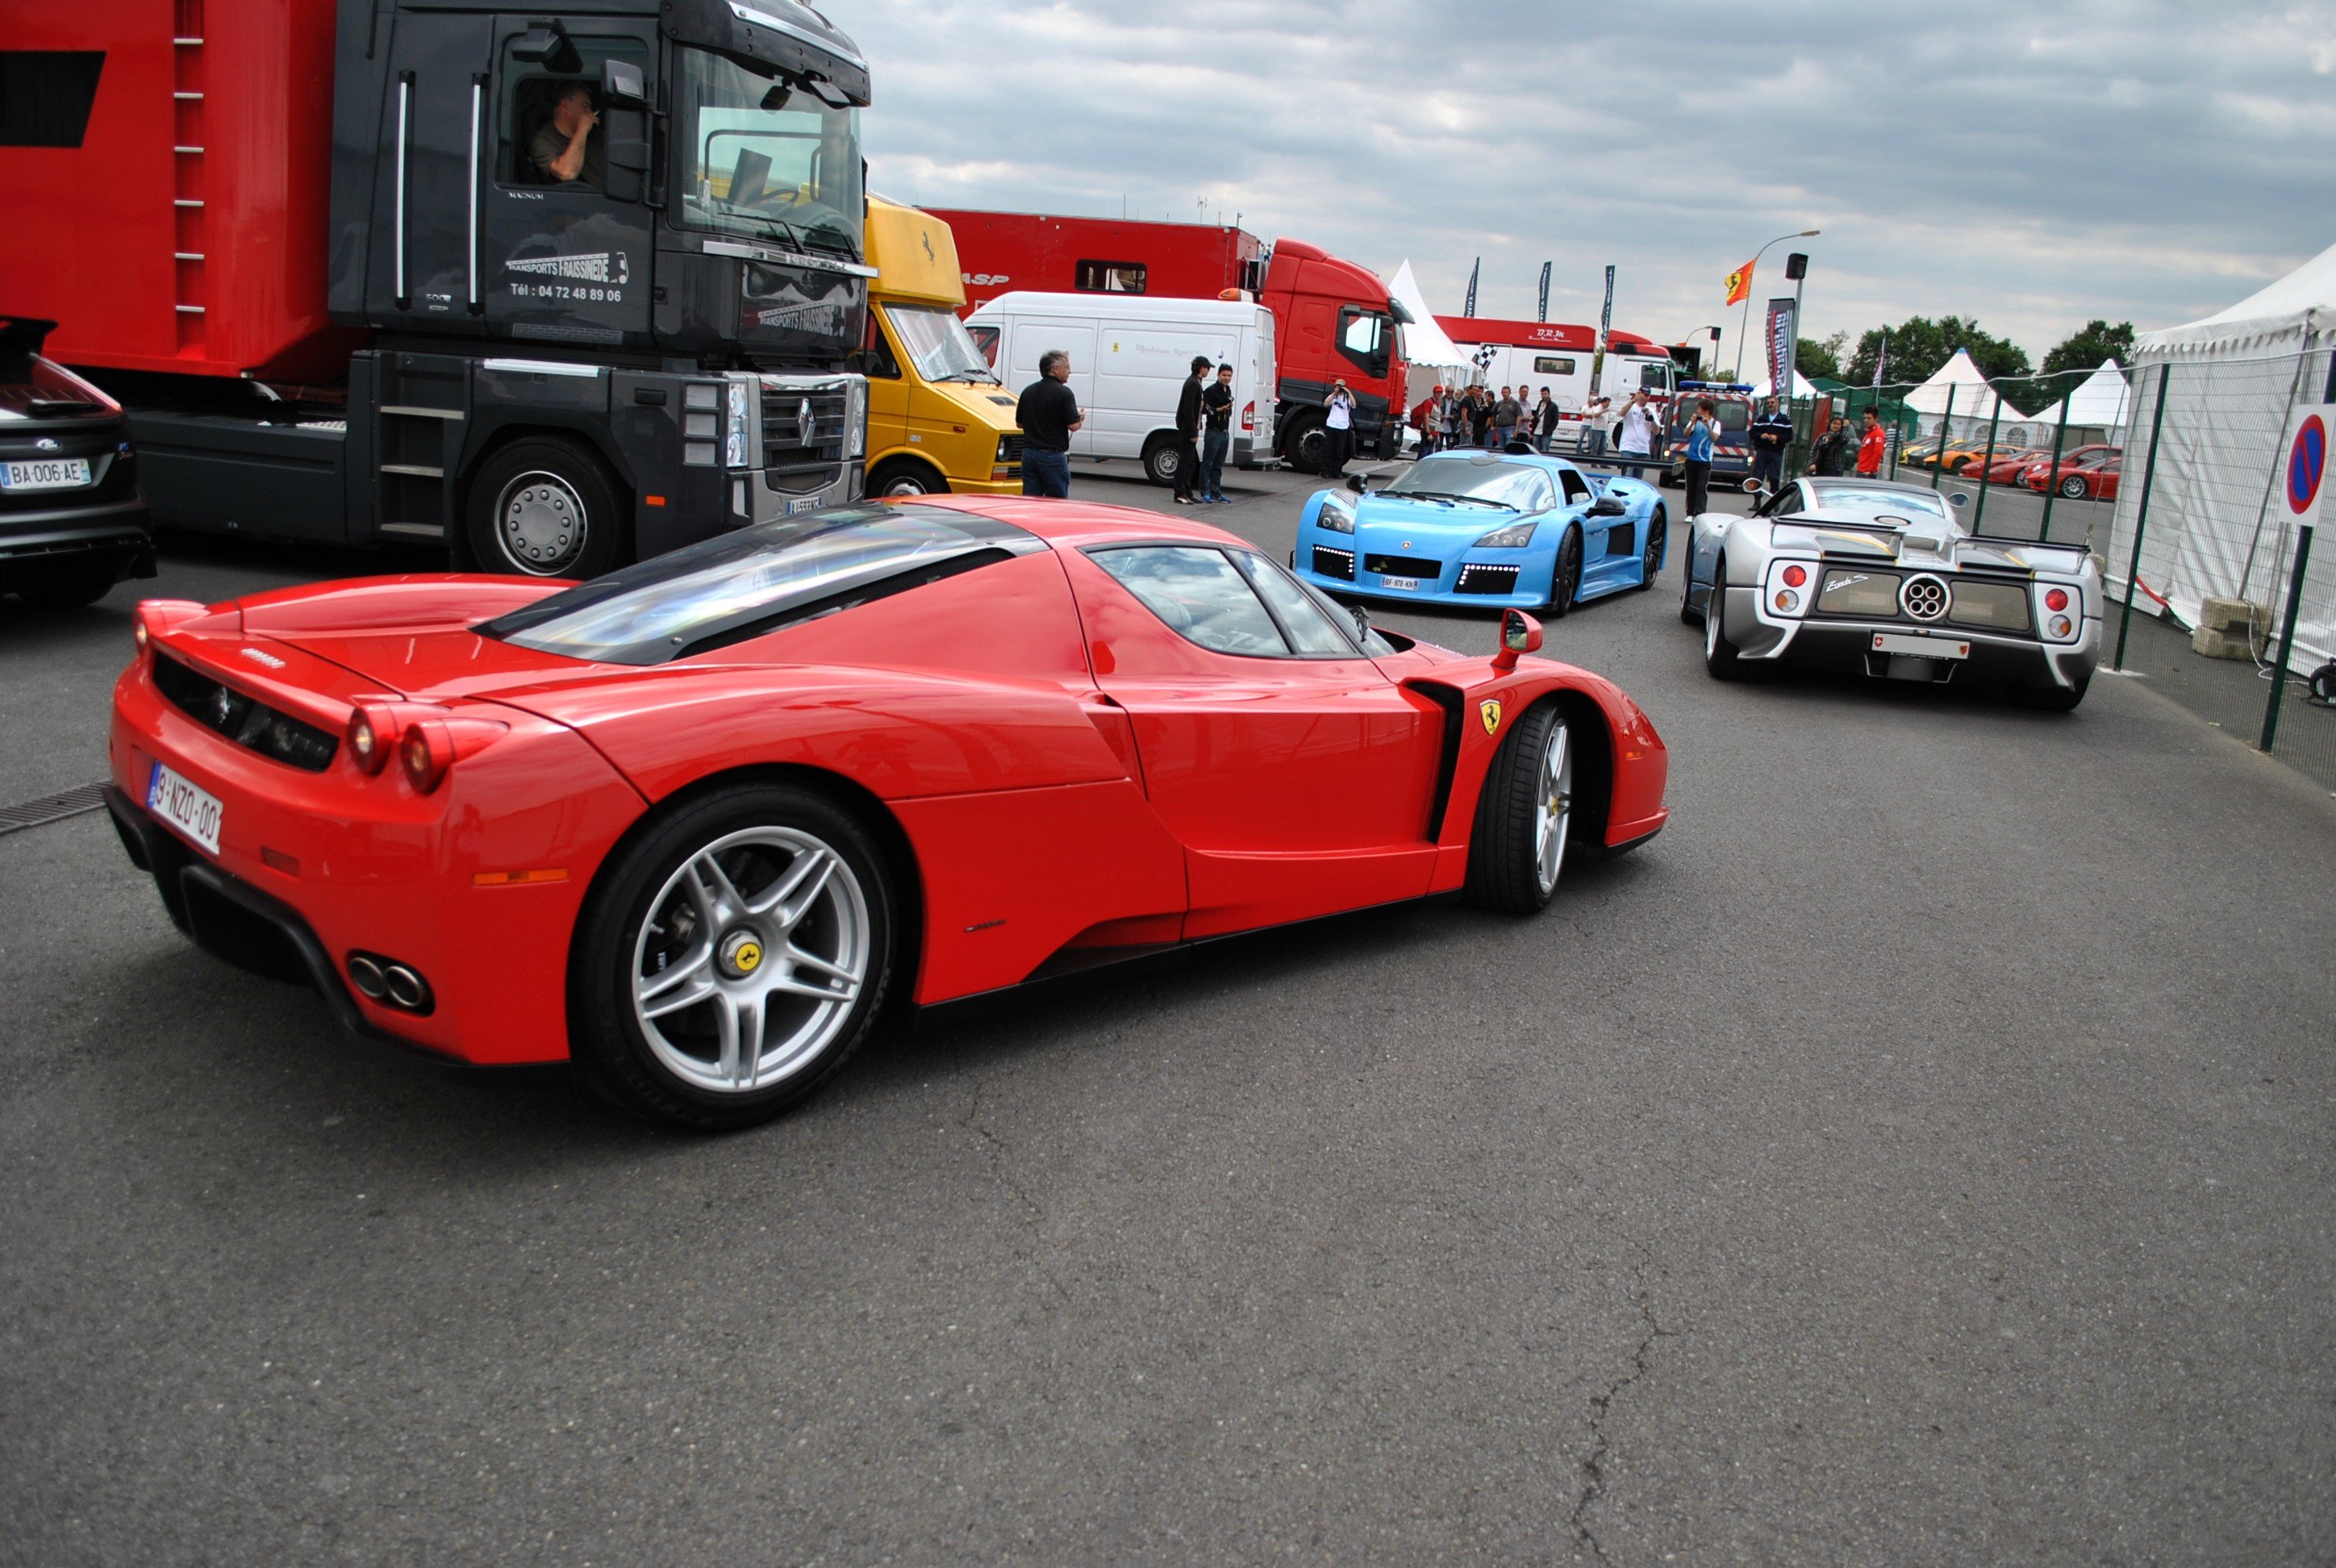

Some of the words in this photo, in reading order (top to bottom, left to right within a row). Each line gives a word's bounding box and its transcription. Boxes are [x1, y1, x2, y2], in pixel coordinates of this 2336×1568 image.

[508, 262, 557, 276] TRANSPORTS
[511, 283, 528, 296] Tél
[539, 286, 553, 298] 04
[556, 286, 569, 299] 72
[573, 287, 587, 300] 48
[590, 289, 604, 301] 89
[607, 290, 622, 302] 06
[760, 311, 800, 330] TRANSPORTS
[11, 463, 80, 484] BA-006-AE
